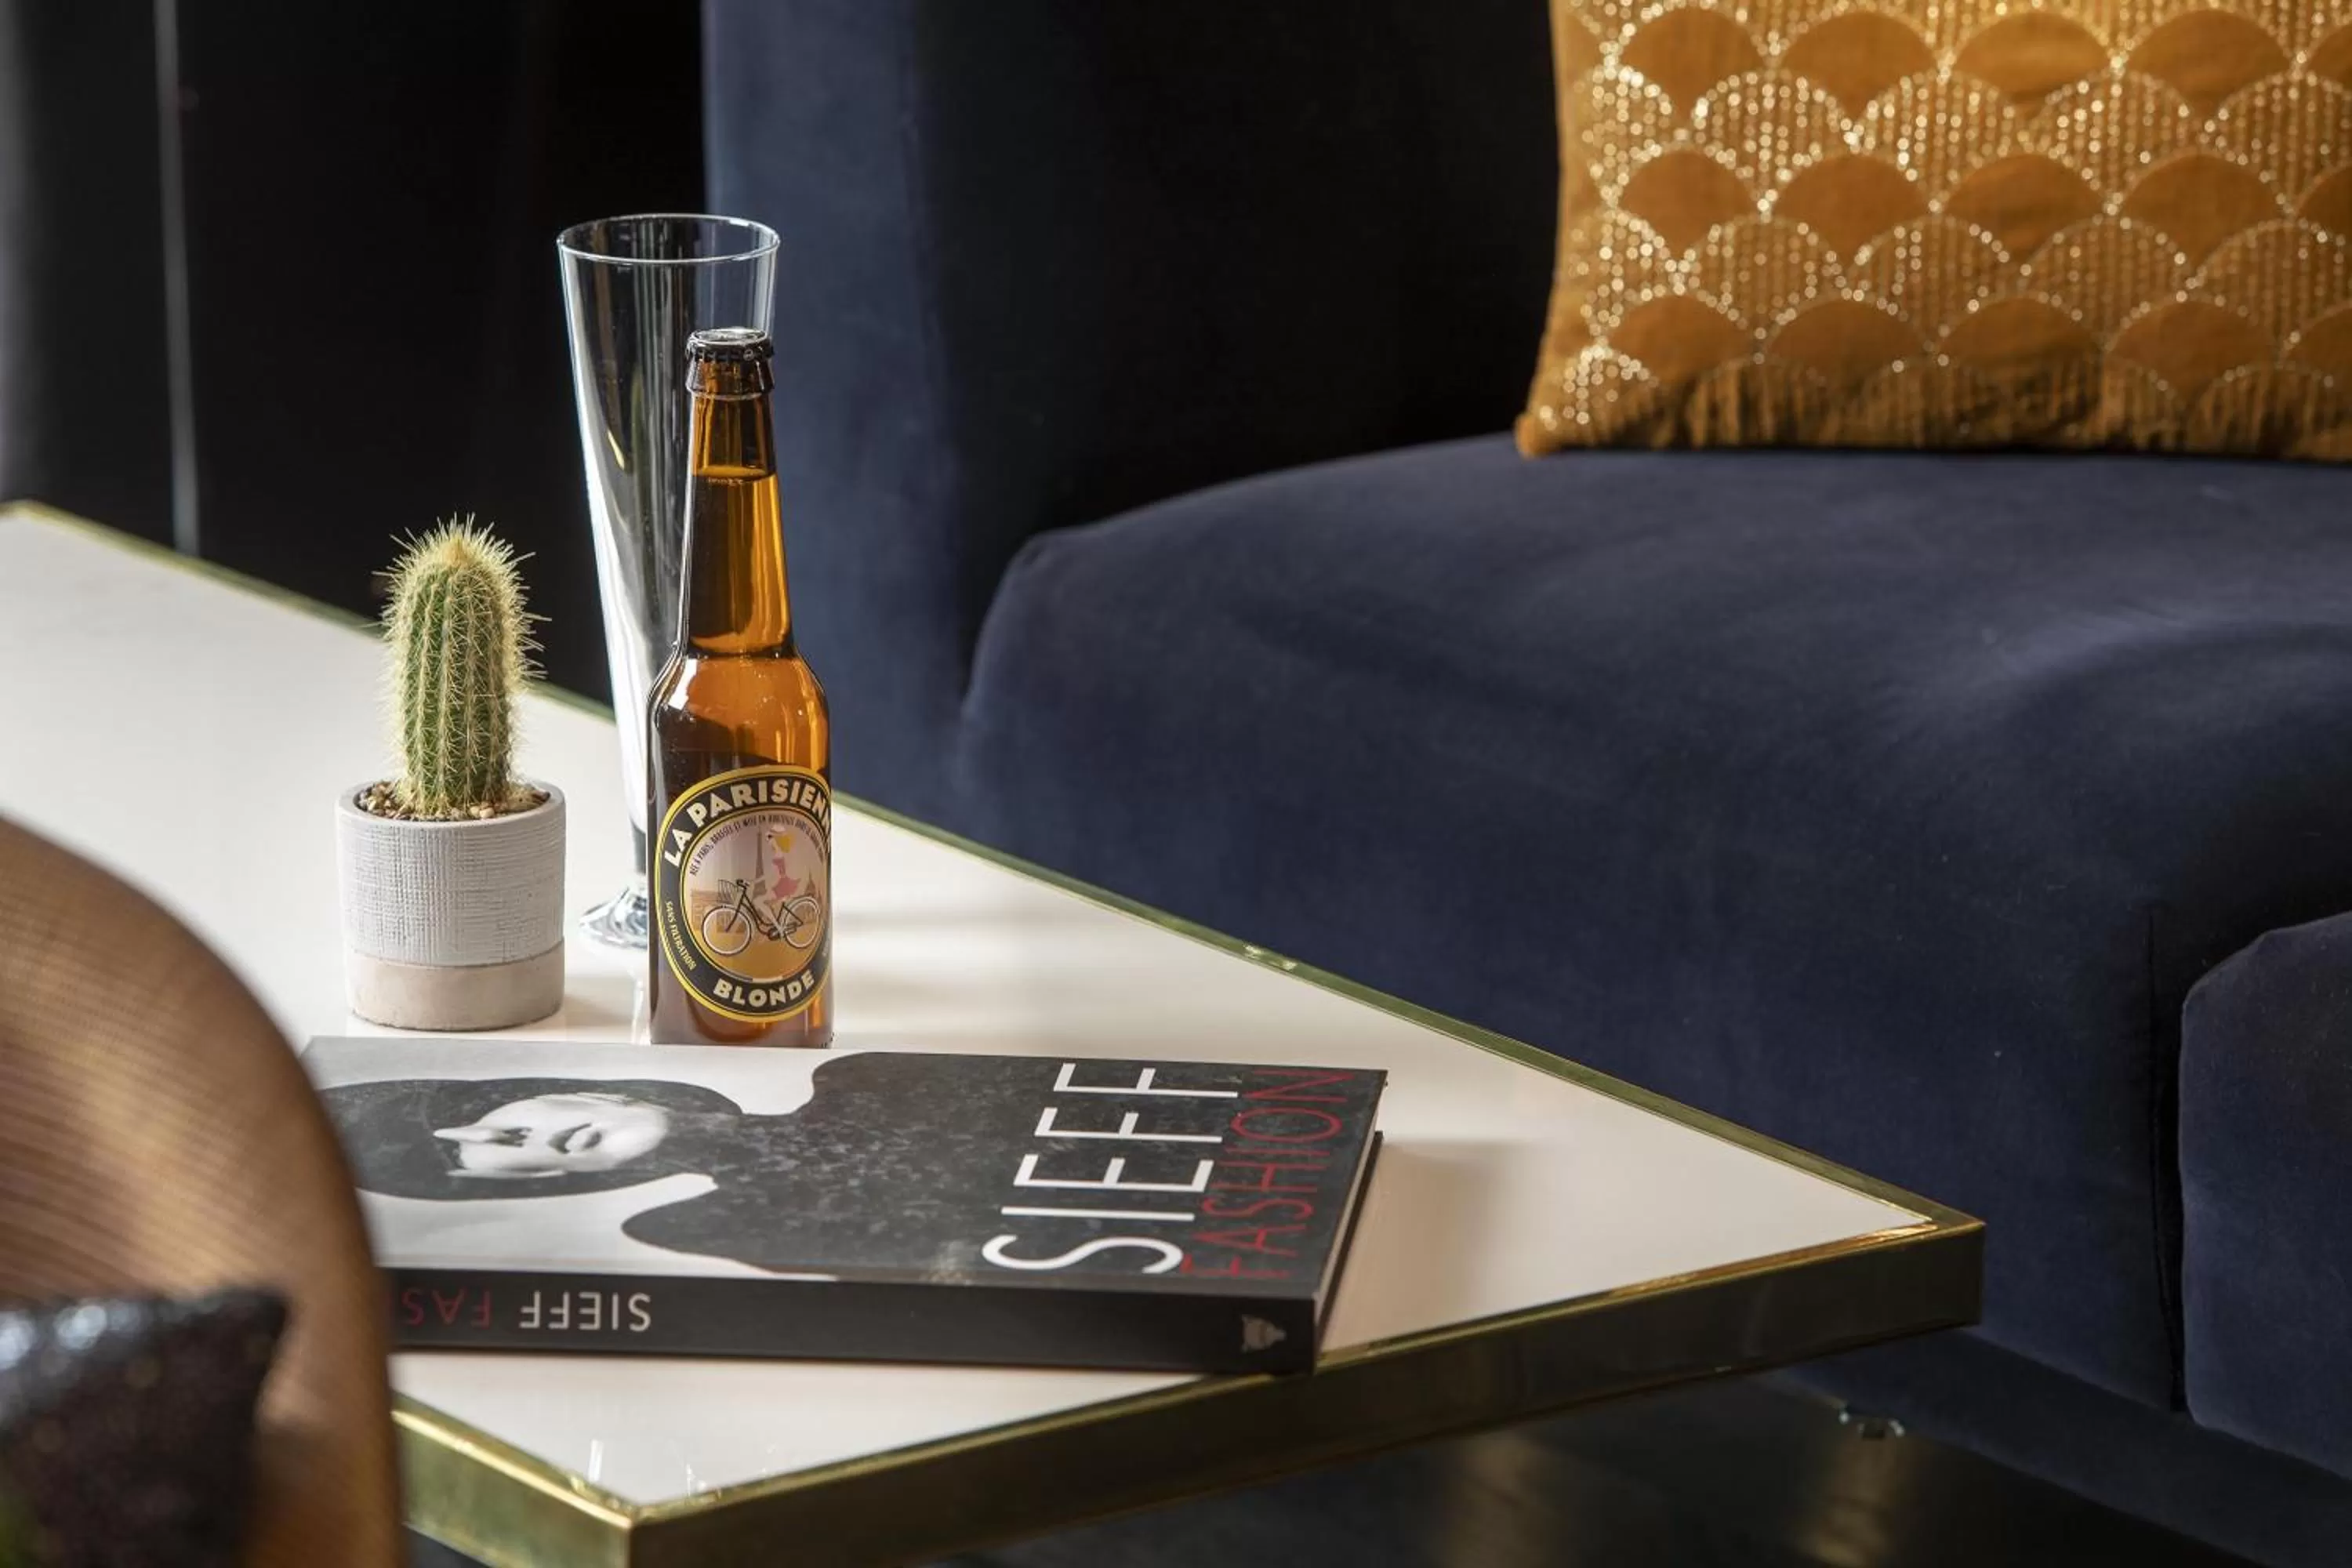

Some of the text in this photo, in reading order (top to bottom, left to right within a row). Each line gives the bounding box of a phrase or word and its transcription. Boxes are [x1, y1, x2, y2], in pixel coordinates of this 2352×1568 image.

[664, 829, 693, 868] LA
[713, 969, 815, 1007] BLONDE
[981, 1062, 1356, 1279] SIEFF FASHION
[385, 1286, 652, 1332] SIEFF FAS
